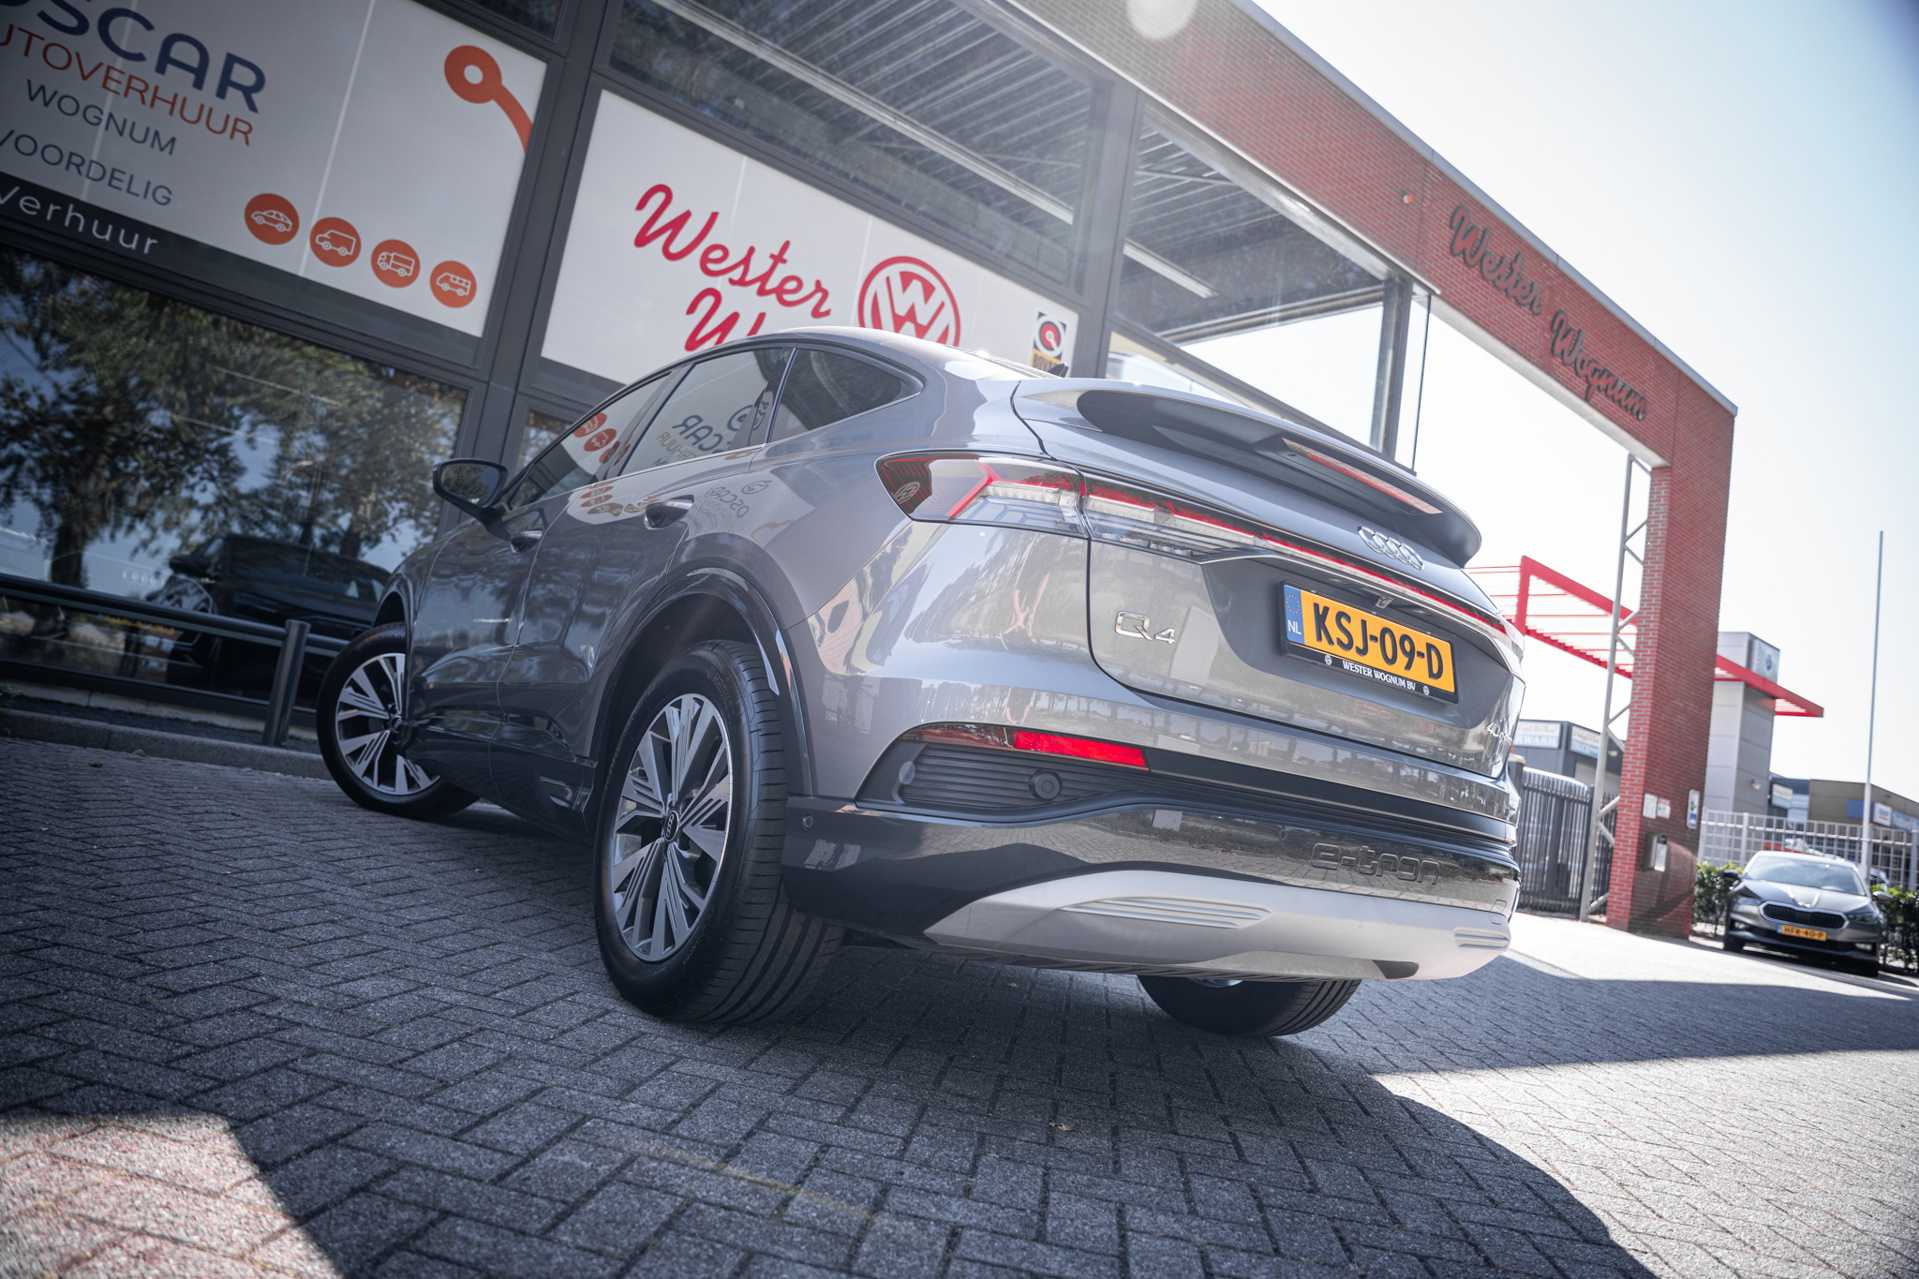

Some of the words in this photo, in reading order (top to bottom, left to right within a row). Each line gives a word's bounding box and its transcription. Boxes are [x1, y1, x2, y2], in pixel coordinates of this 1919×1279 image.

[0, 0, 266, 114] SCAR
[27, 79, 176, 156] WOGNUM
[633, 184, 832, 319] Wester
[1450, 205, 1543, 317] Wester
[1550, 310, 1648, 421] Wognum
[1114, 610, 1175, 644] Q4
[1287, 619, 1302, 635] NL
[1313, 602, 1444, 681] KSJ-09-D
[1342, 660, 1373, 678] WESTER
[1374, 669, 1406, 688] WOGNUM
[1407, 680, 1416, 691] BV
[1310, 842, 1440, 886] e-tron
